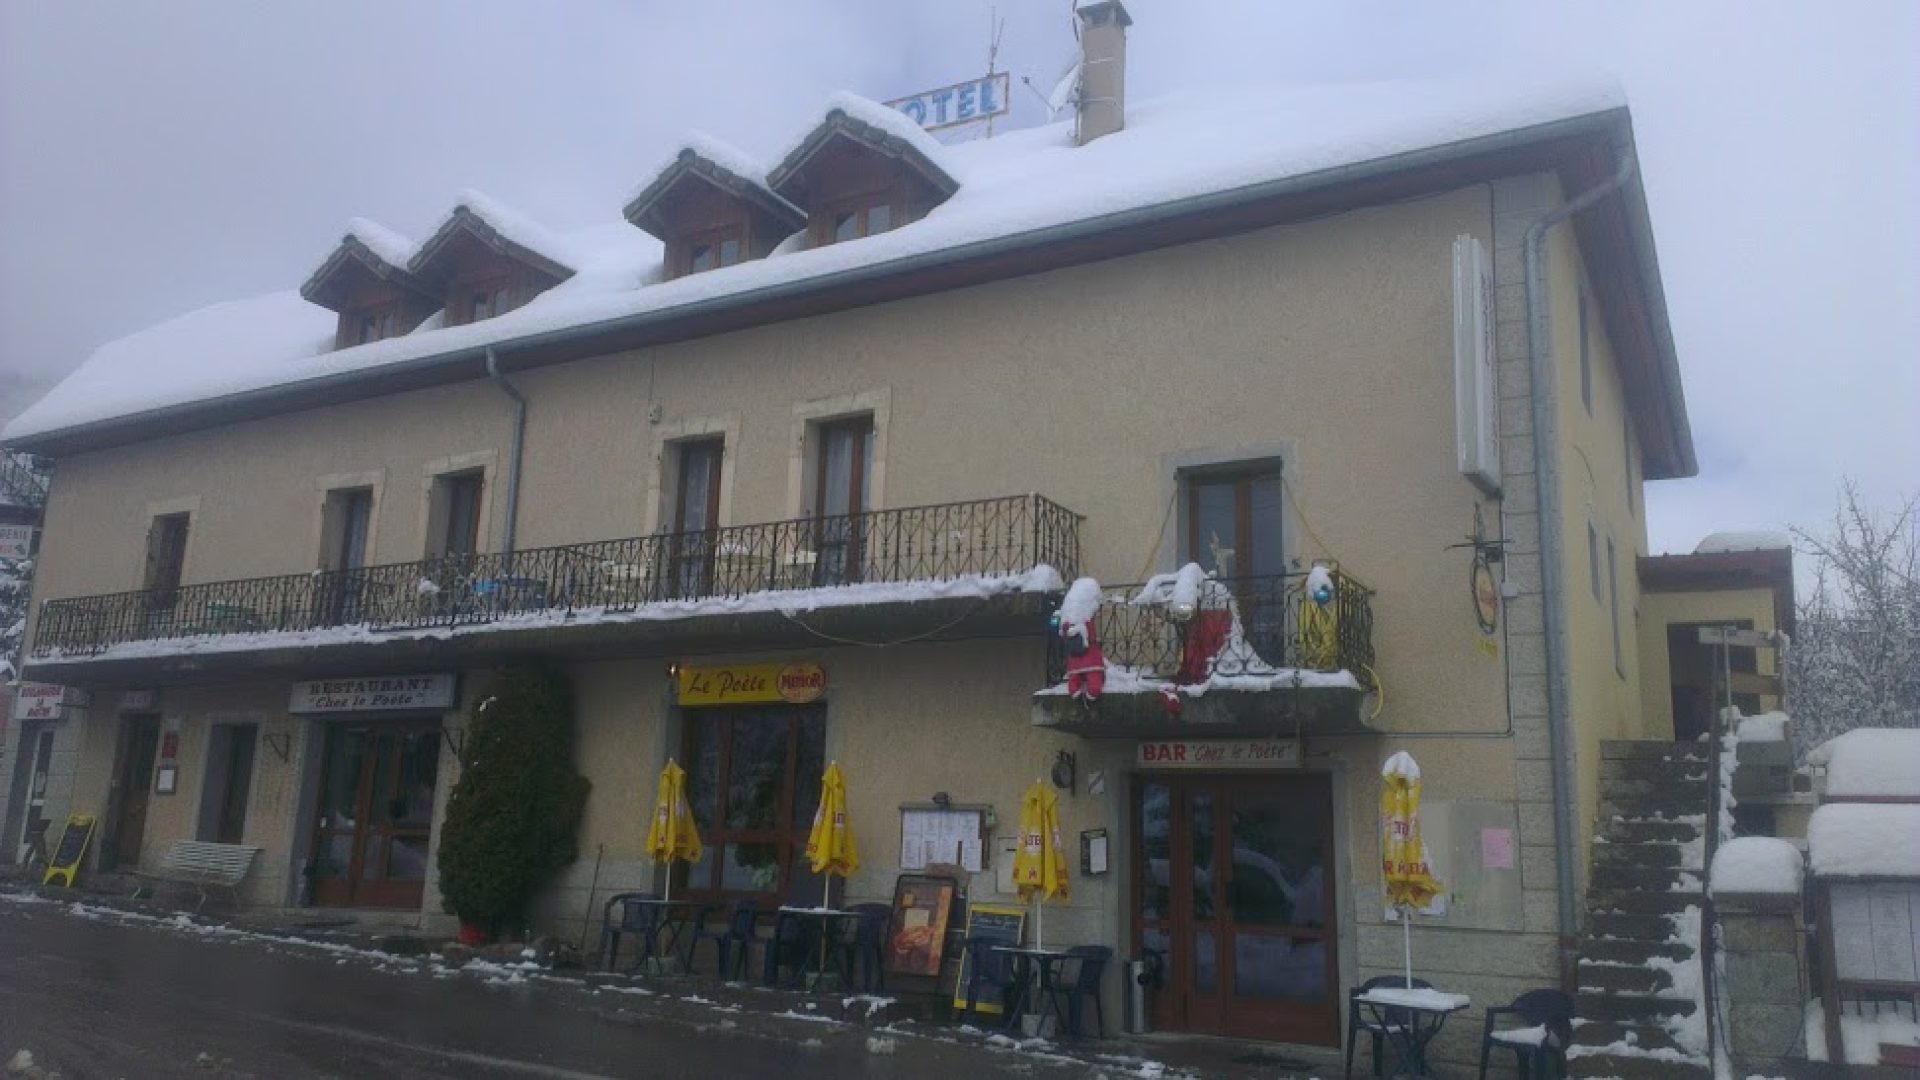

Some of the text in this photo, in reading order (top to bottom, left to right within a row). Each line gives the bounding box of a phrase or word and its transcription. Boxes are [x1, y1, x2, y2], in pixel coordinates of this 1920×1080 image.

[893, 79, 997, 127] OTEL
[310, 678, 432, 694] RESTAURANT
[688, 671, 711, 694] Le
[1142, 743, 1186, 761] BAR
